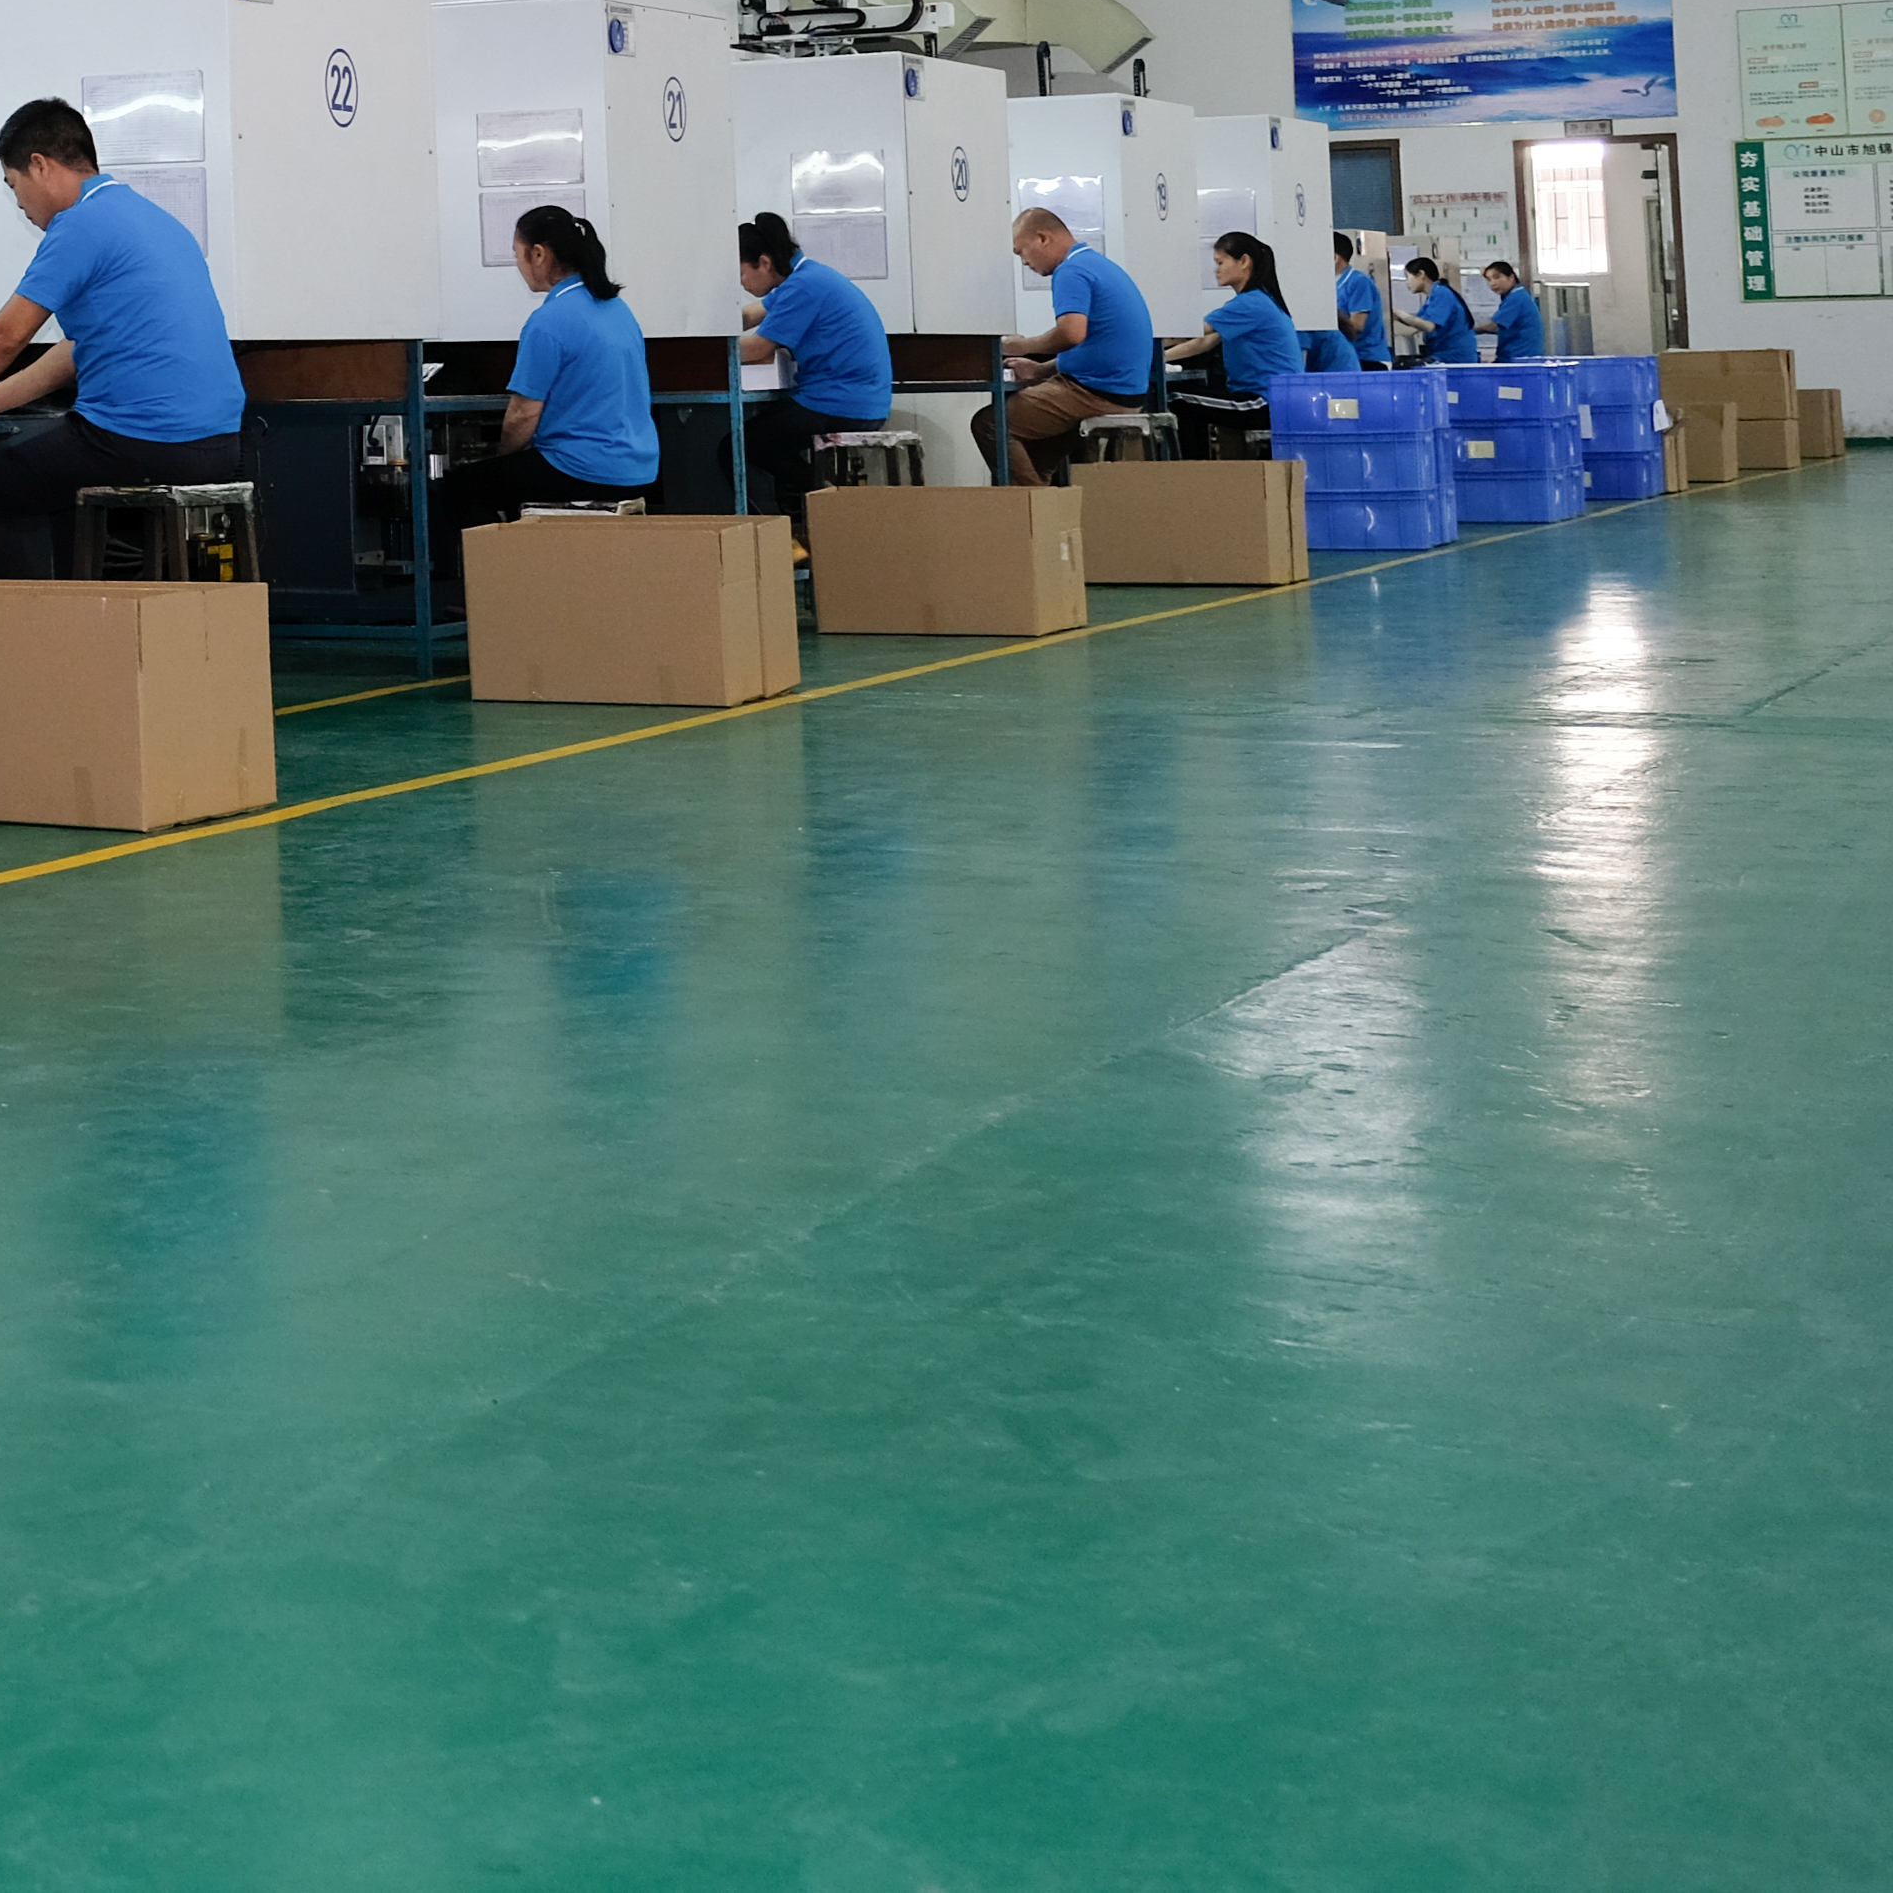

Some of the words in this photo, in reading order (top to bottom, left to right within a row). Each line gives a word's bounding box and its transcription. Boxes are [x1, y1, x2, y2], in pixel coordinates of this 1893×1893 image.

[330, 63, 353, 111] 22
[666, 90, 684, 129] 21
[954, 158, 968, 190] 20
[1156, 183, 1167, 211] 19
[1739, 150, 1767, 292] 夯实基础管理
